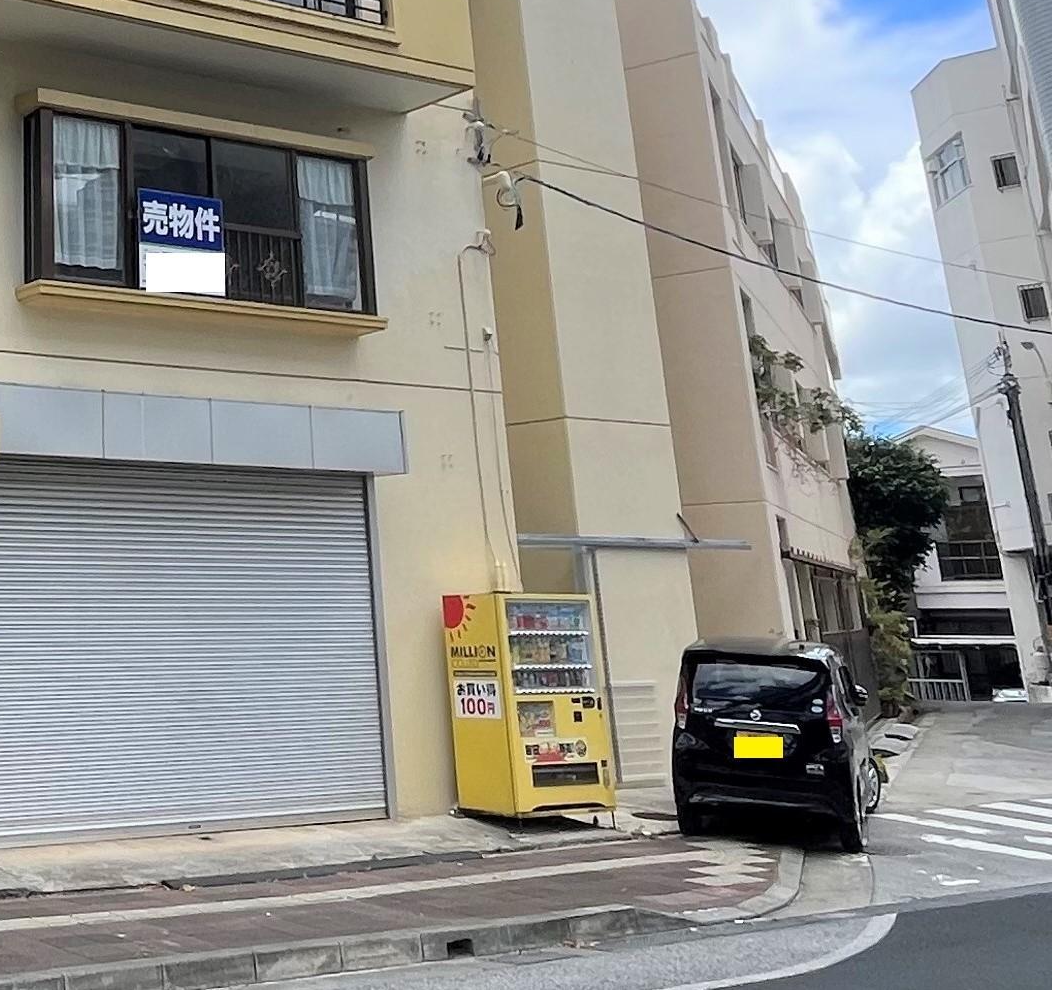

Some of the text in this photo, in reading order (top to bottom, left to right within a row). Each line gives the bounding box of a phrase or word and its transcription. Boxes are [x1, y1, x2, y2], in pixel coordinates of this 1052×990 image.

[142, 200, 221, 243] 売物件
[451, 645, 496, 658] MILLION
[460, 697, 495, 715] 100円
